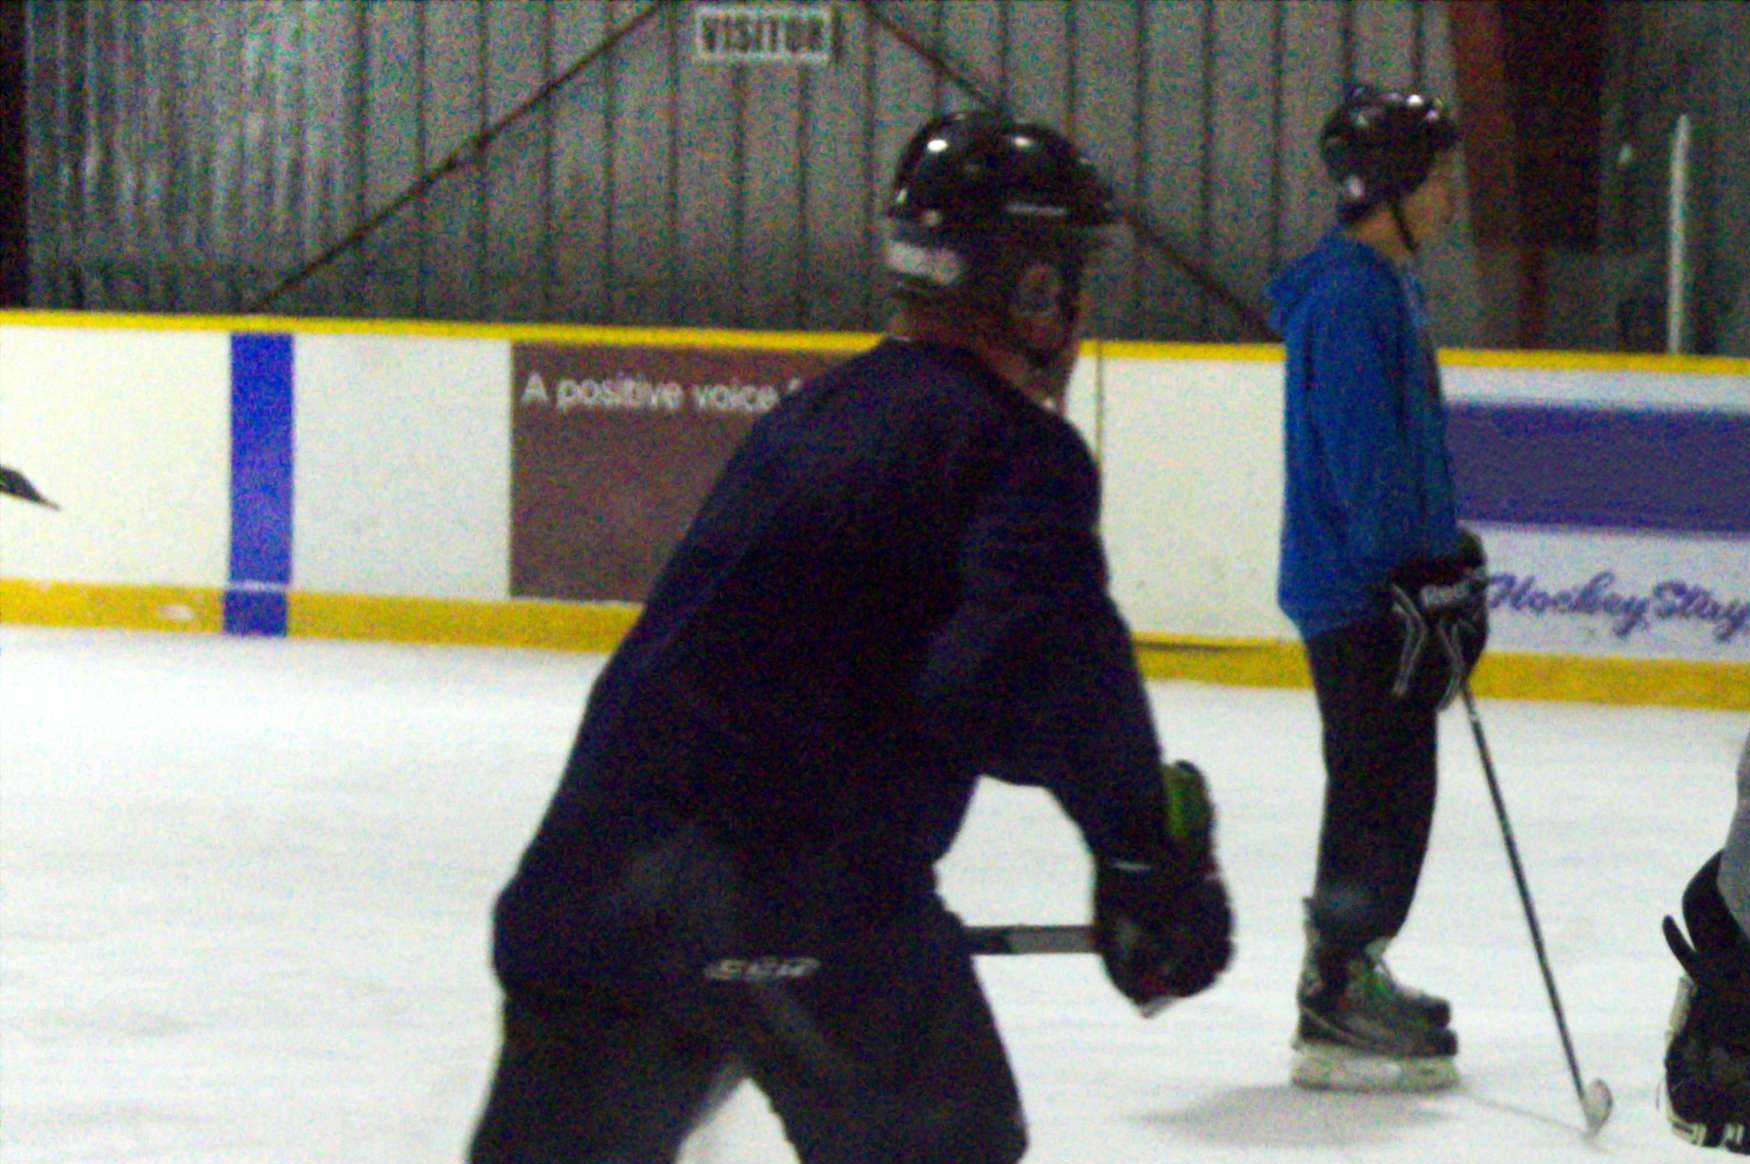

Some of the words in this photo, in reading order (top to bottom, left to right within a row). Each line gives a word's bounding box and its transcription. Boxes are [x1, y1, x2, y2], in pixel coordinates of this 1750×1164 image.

[702, 14, 826, 54] VISITOR
[521, 371, 550, 405] A
[556, 371, 685, 414] positive
[691, 376, 780, 413] voice
